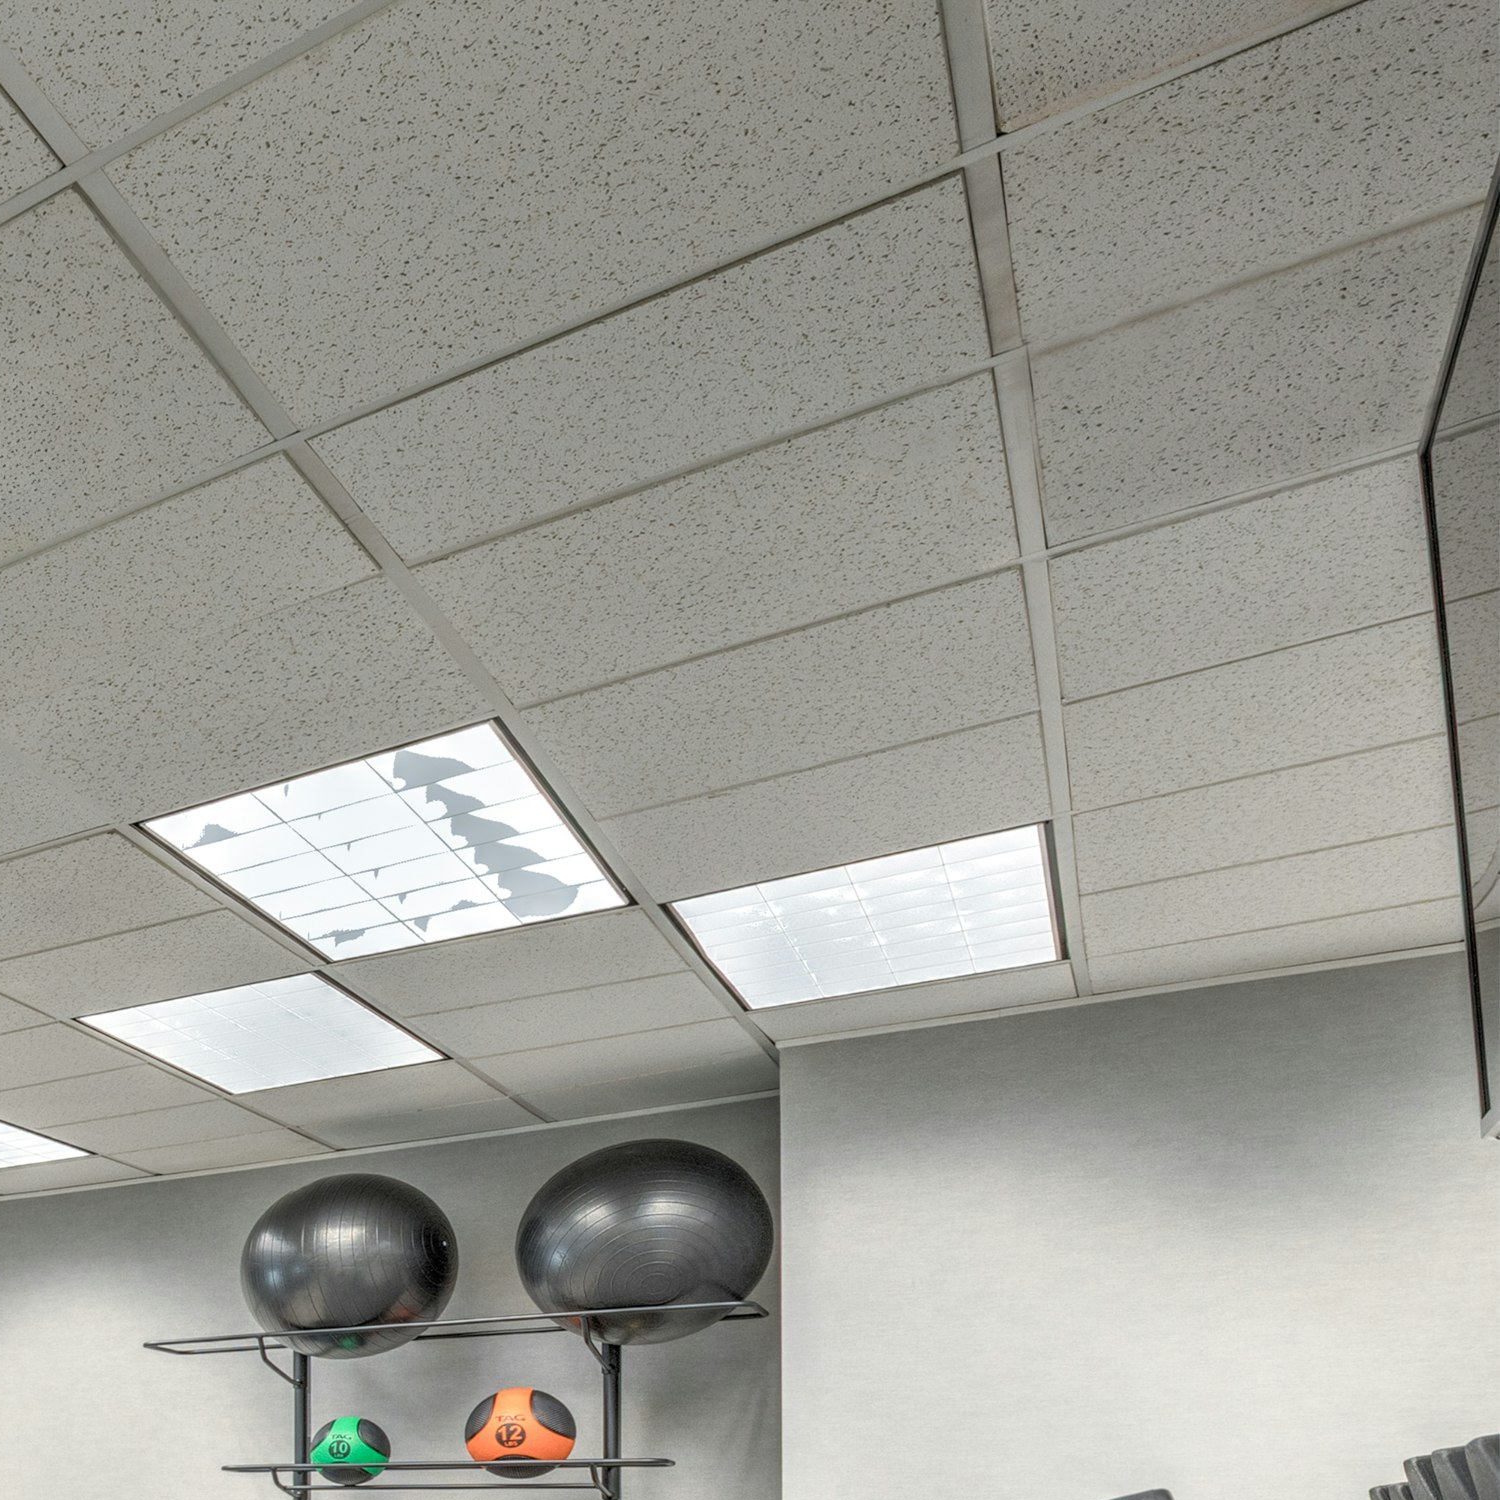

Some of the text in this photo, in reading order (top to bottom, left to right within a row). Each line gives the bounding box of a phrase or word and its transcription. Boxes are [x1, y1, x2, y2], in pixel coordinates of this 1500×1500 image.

[495, 1414, 526, 1422] TAG
[497, 1424, 524, 1441] 12
[330, 1441, 349, 1454] 10
